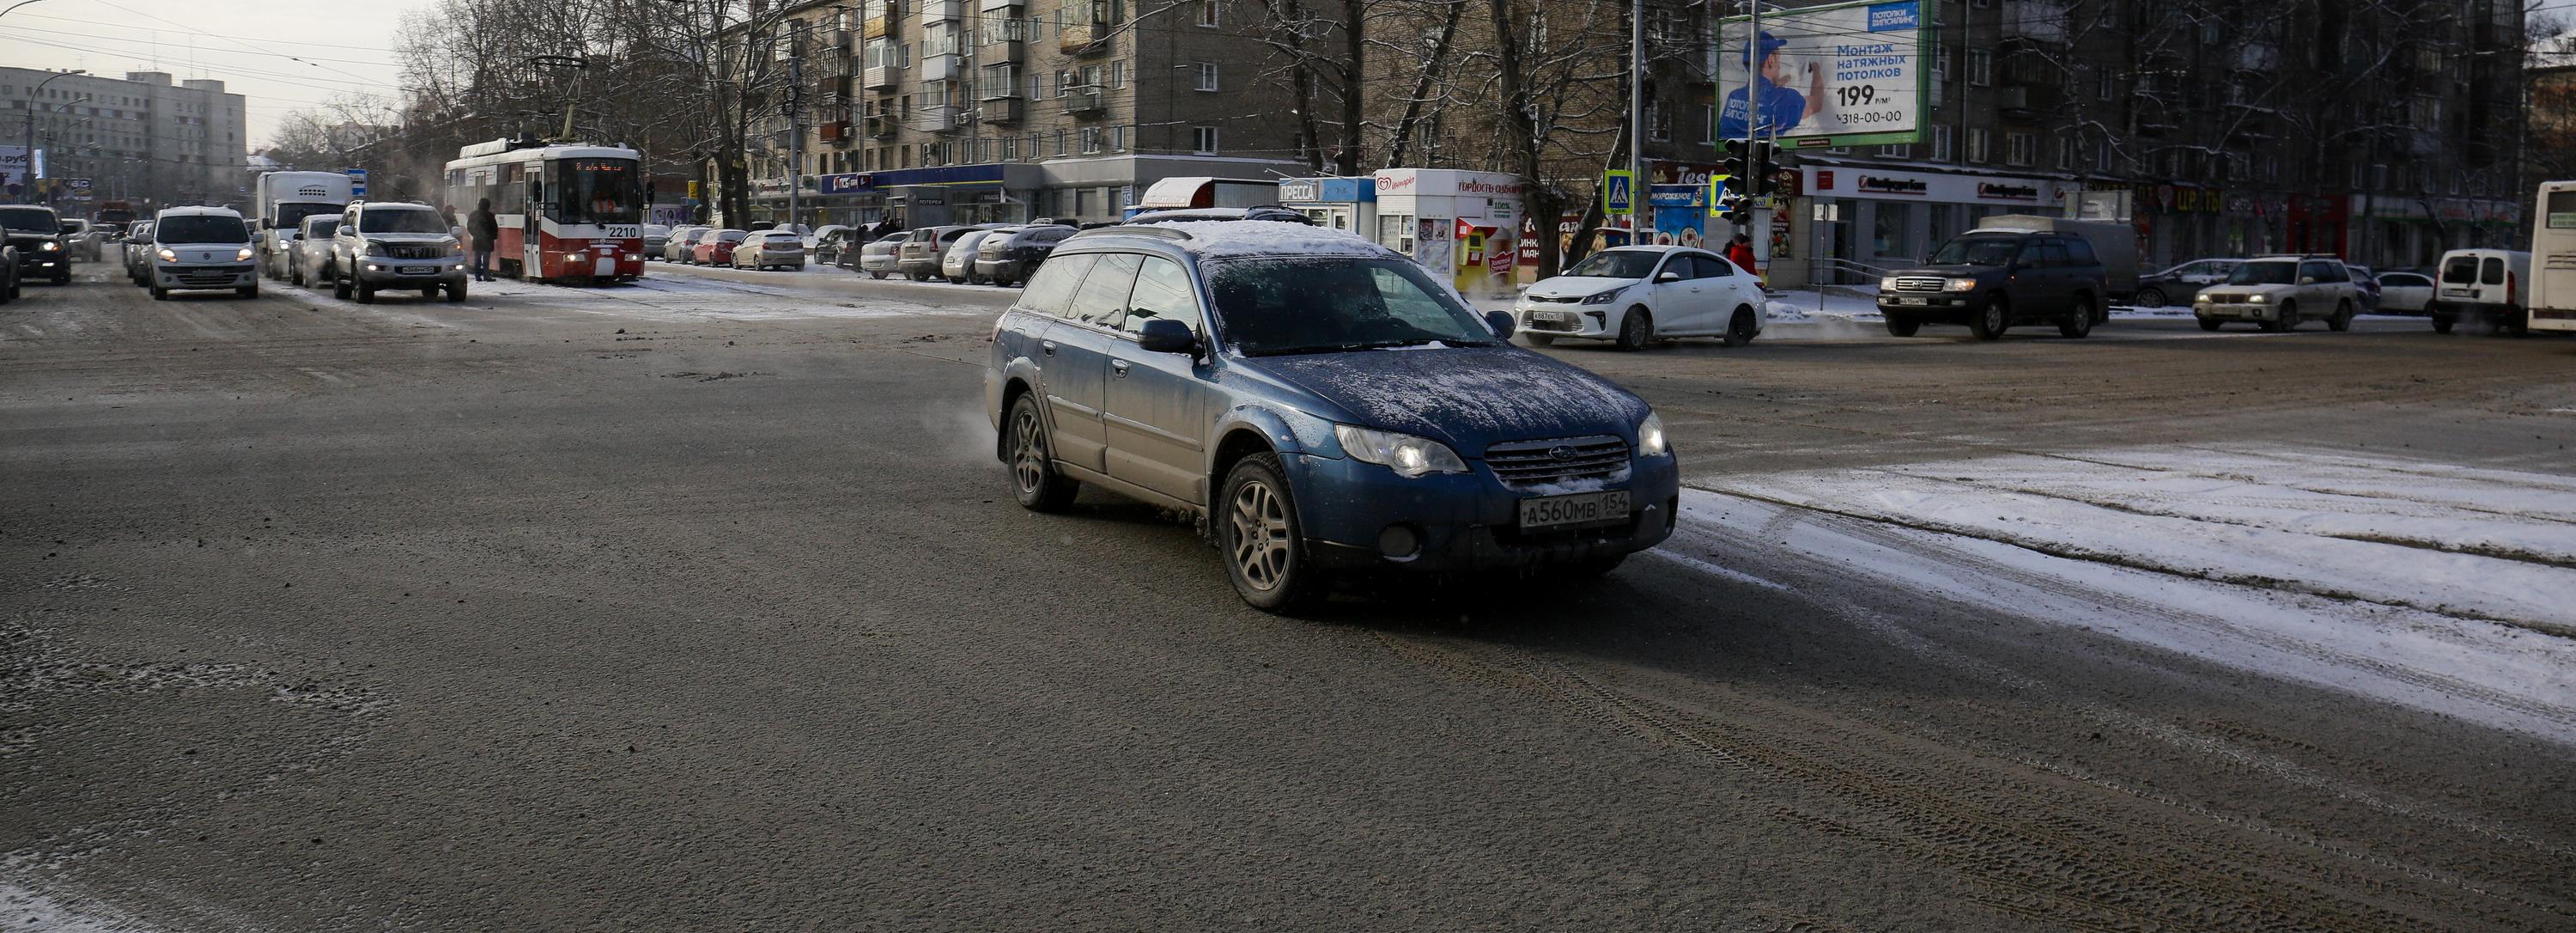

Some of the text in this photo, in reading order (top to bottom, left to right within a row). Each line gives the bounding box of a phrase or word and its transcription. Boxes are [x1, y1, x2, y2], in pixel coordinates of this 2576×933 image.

[1872, 9, 1906, 19] ПОТОЛКИ
[1838, 44, 1893, 57] Монтаж
[1837, 55, 1905, 69] натяжных
[1837, 68, 1901, 81] потолков
[1837, 85, 1874, 107] 199
[1842, 111, 1901, 124] 318-00-00
[1280, 185, 1314, 200] ПРЕССА
[1649, 192, 1691, 200] МОРОЖЕНОЕ
[610, 228, 635, 237] 2210
[1519, 238, 1539, 247] ИНК
[1528, 493, 1628, 524] А560МВ 154
